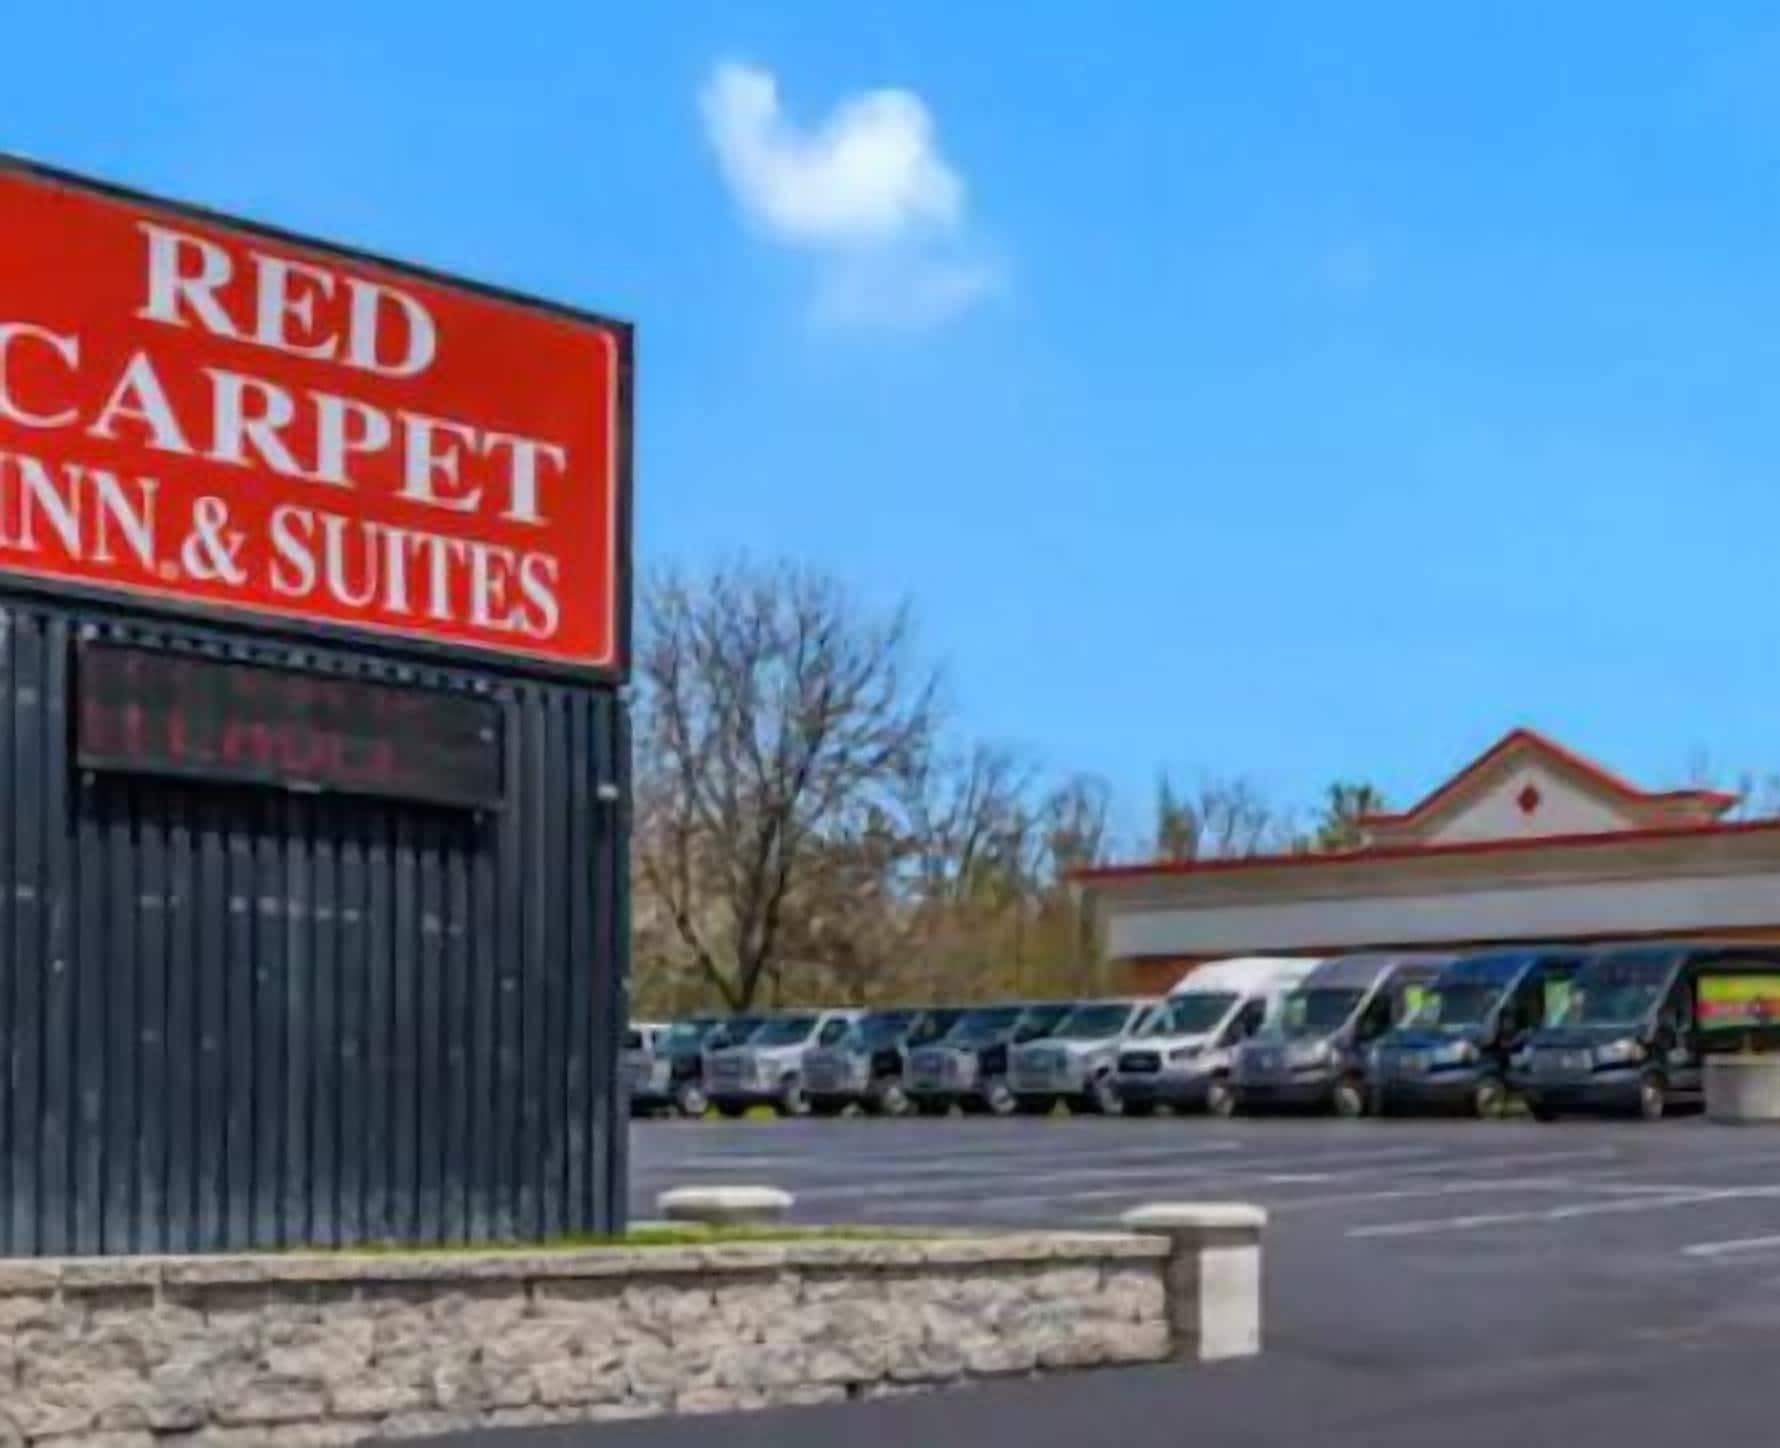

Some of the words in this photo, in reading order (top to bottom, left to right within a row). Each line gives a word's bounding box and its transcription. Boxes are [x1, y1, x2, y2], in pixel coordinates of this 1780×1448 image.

[137, 220, 438, 379] RED
[0, 322, 567, 526] CARPET
[181, 496, 248, 586] &
[268, 504, 560, 640] SUITES
